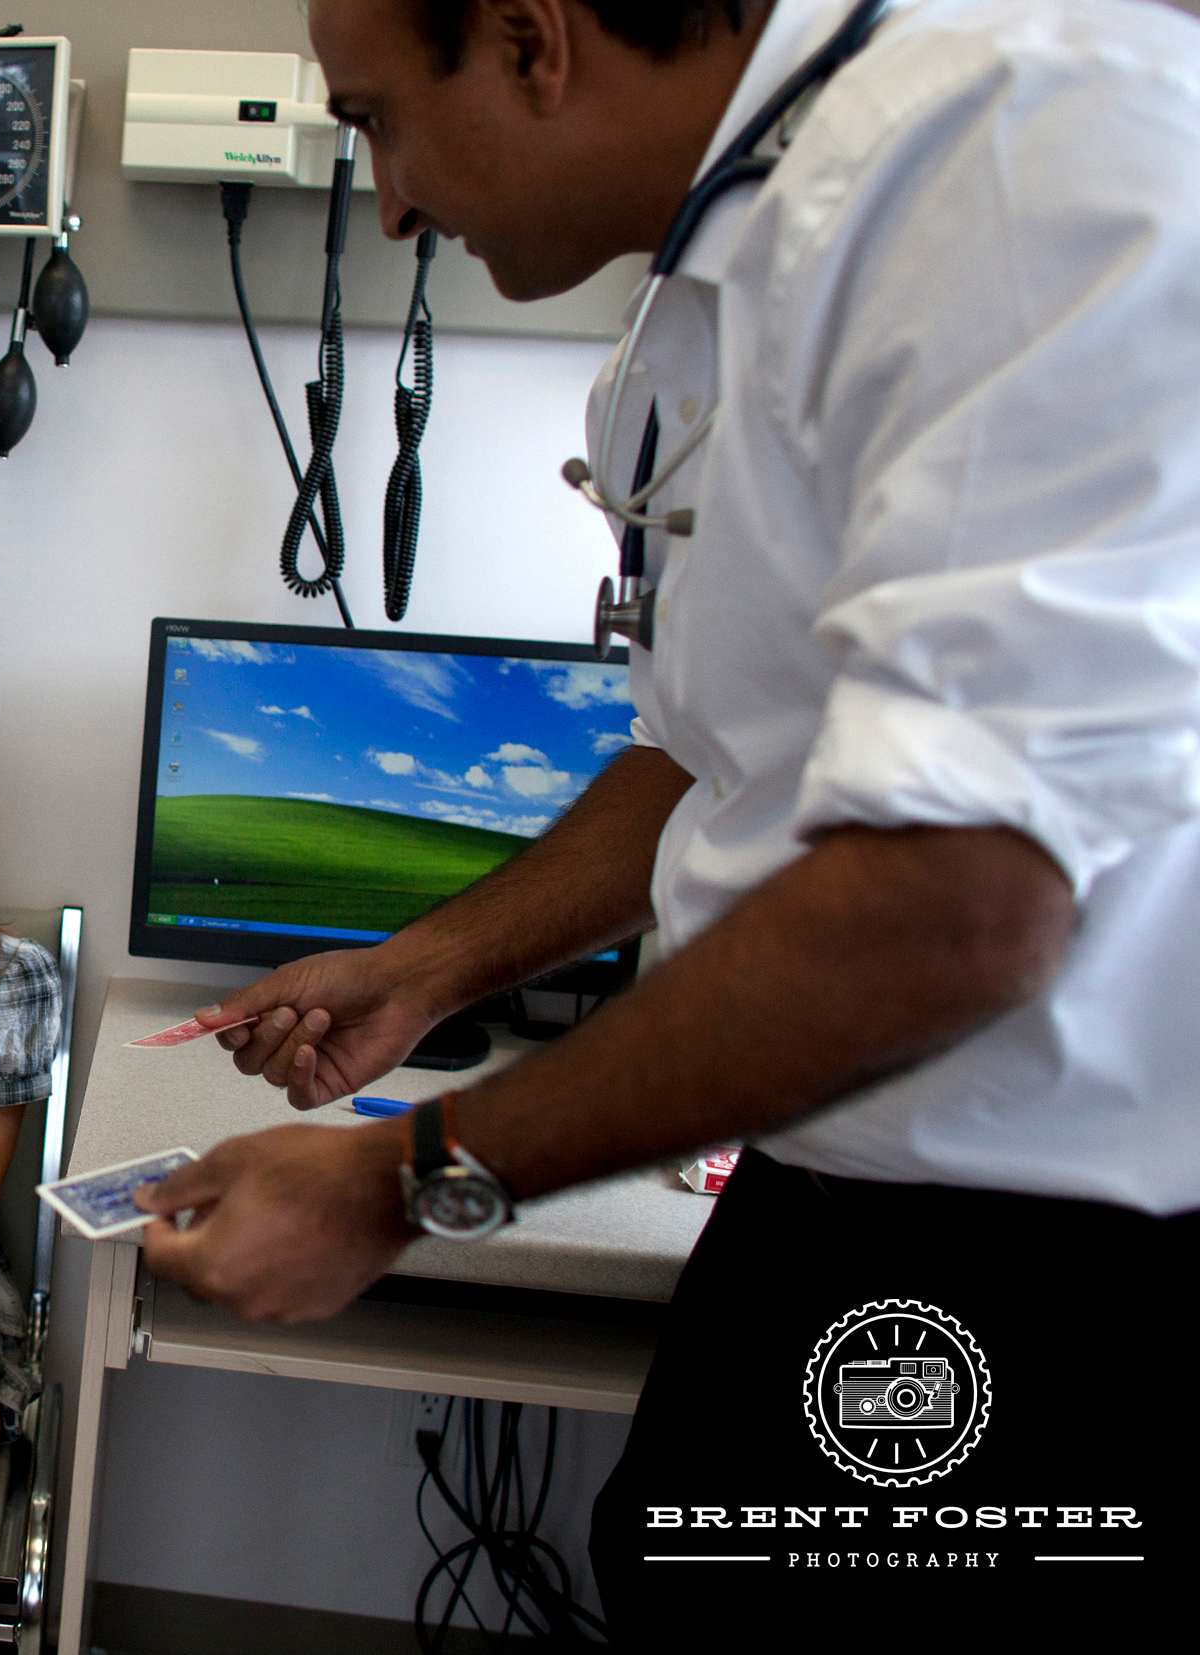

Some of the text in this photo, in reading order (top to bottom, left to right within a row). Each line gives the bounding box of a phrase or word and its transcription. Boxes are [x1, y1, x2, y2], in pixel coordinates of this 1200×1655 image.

[6, 101, 25, 111] 200
[12, 120, 31, 131] 220
[13, 139, 32, 150] 240
[8, 159, 26, 169] 260
